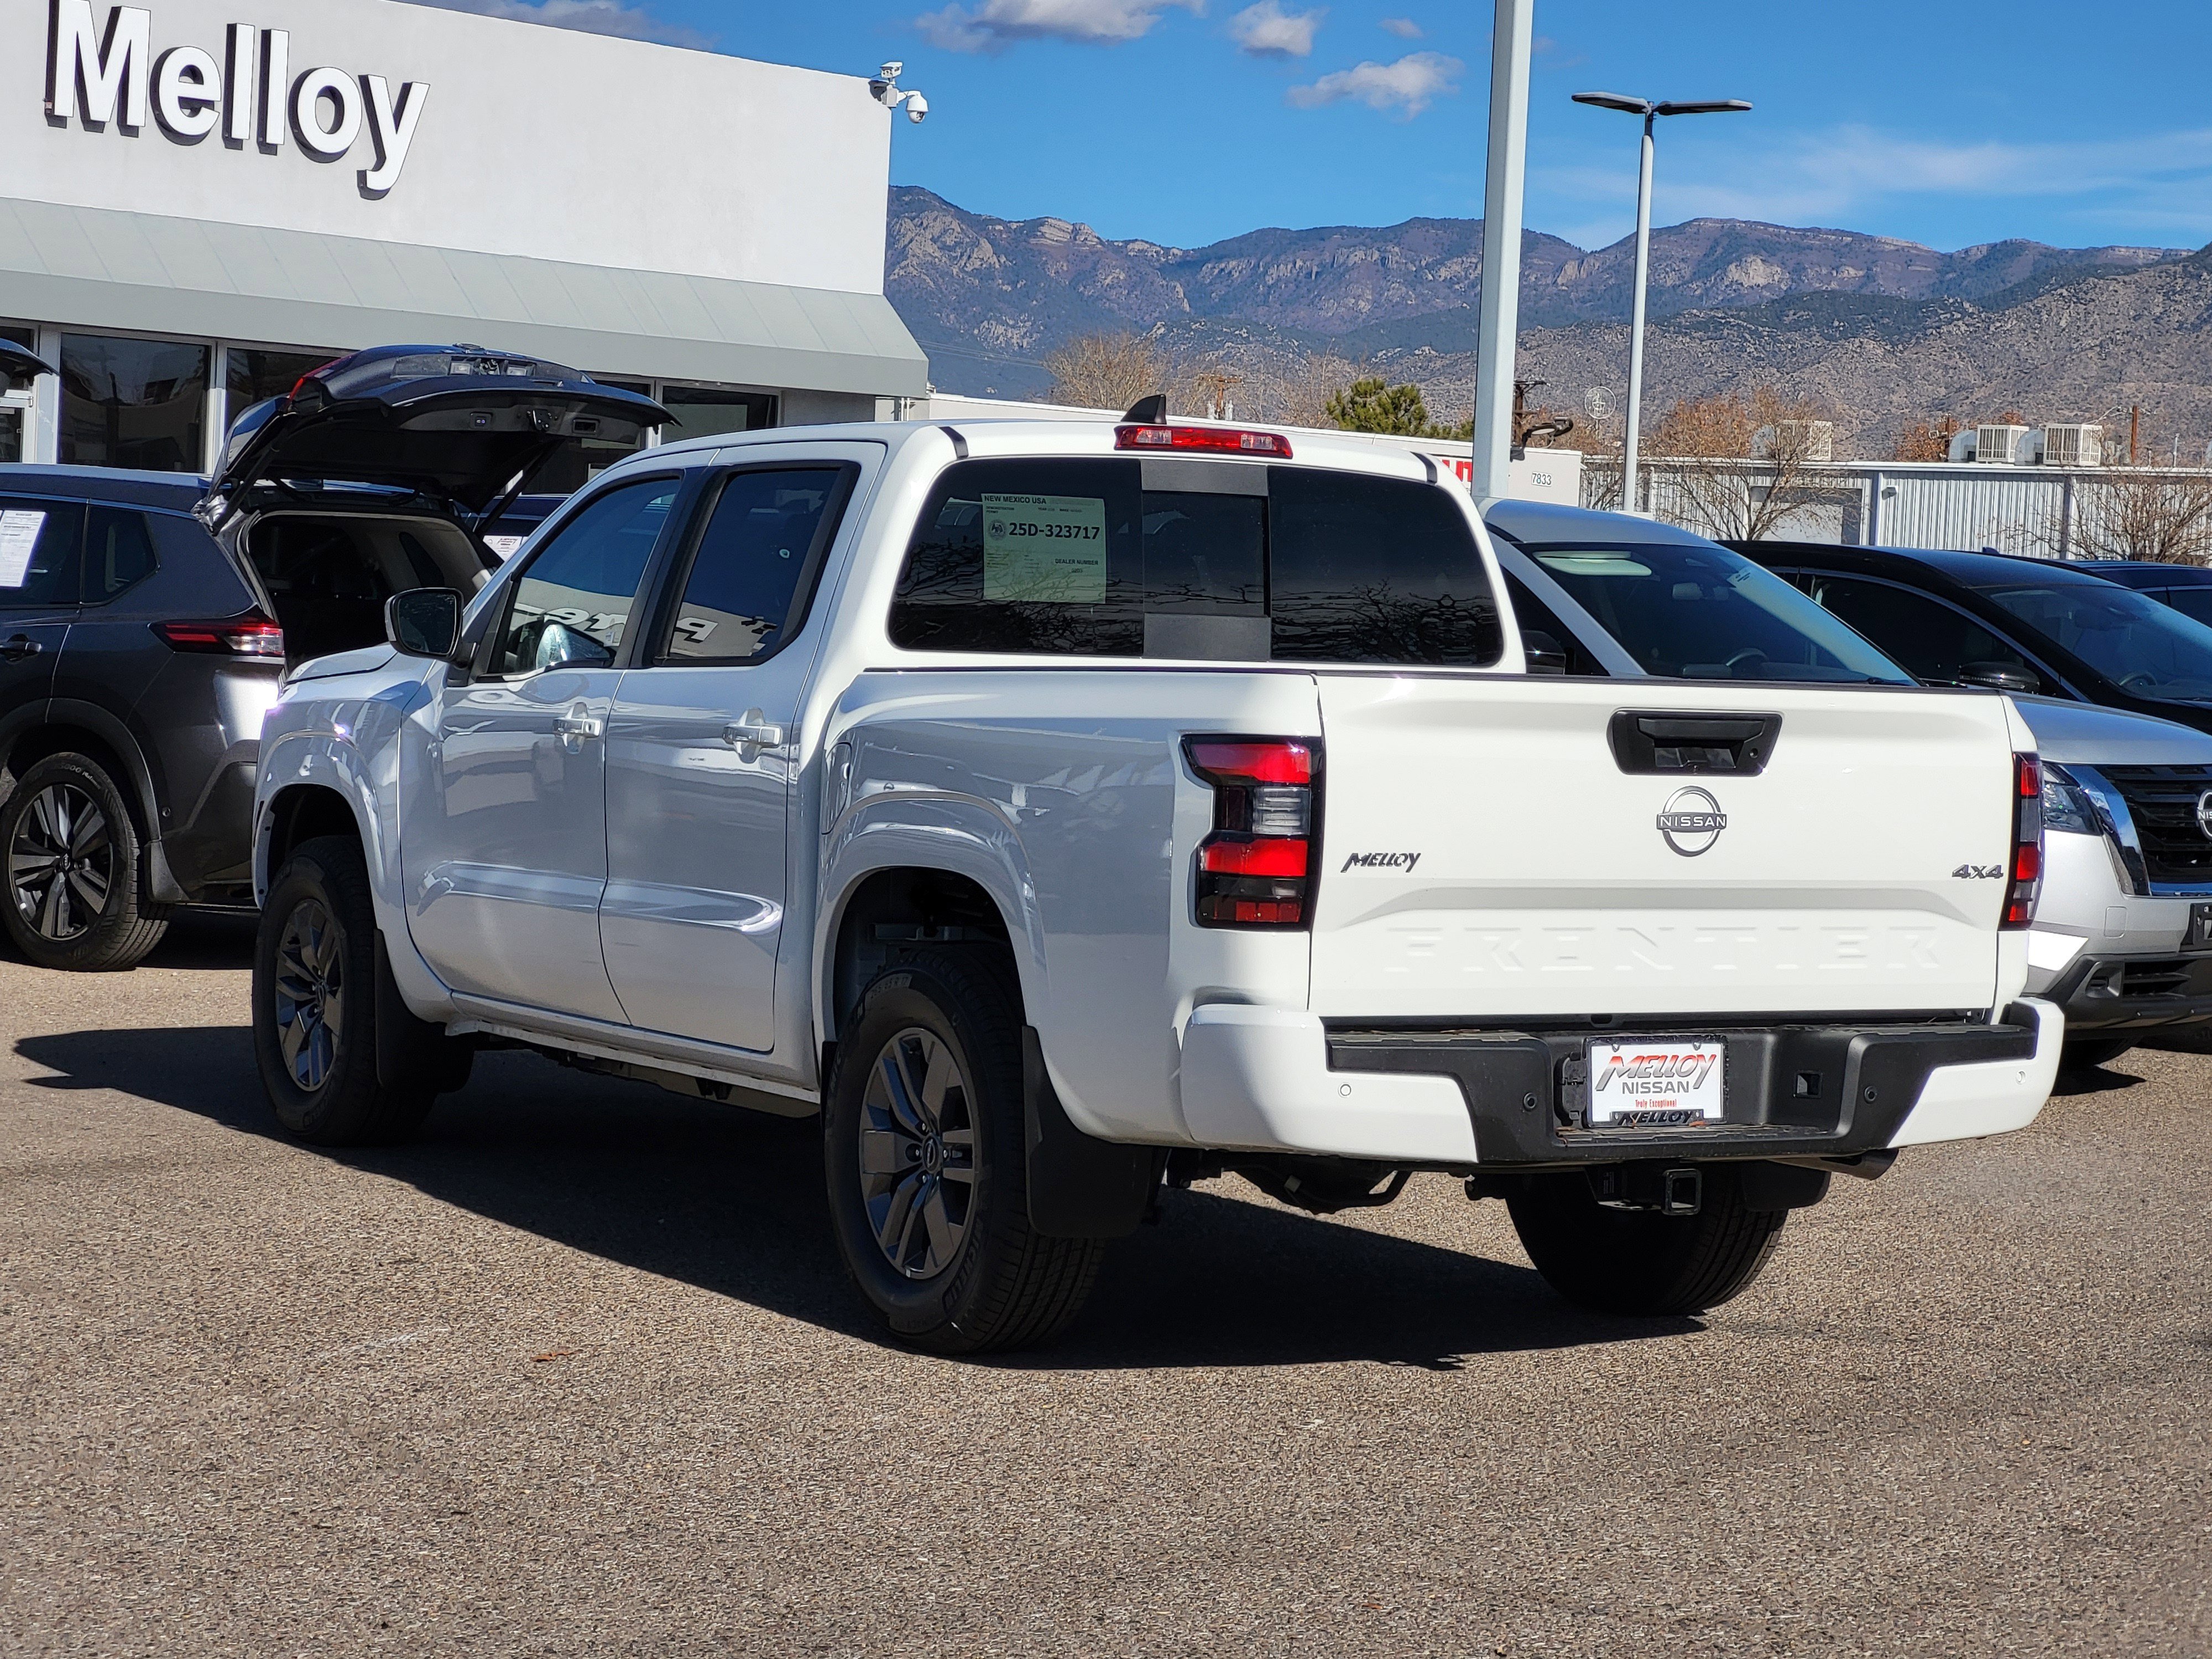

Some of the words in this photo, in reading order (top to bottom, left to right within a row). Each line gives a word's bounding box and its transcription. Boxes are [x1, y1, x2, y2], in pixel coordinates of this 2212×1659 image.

[46, 0, 430, 200] Melloy
[1532, 473, 1551, 485] 7833
[1009, 523, 1100, 540] 25D-323717
[1660, 816, 1726, 827] NISSAN
[1340, 852, 1422, 873] MELLOY
[1383, 926, 1939, 972] FRONTIER
[1595, 1054, 1717, 1091] MELLOY
[1622, 1081, 1689, 1094] NISSAN
[1618, 1110, 1693, 1126] MELLOY
